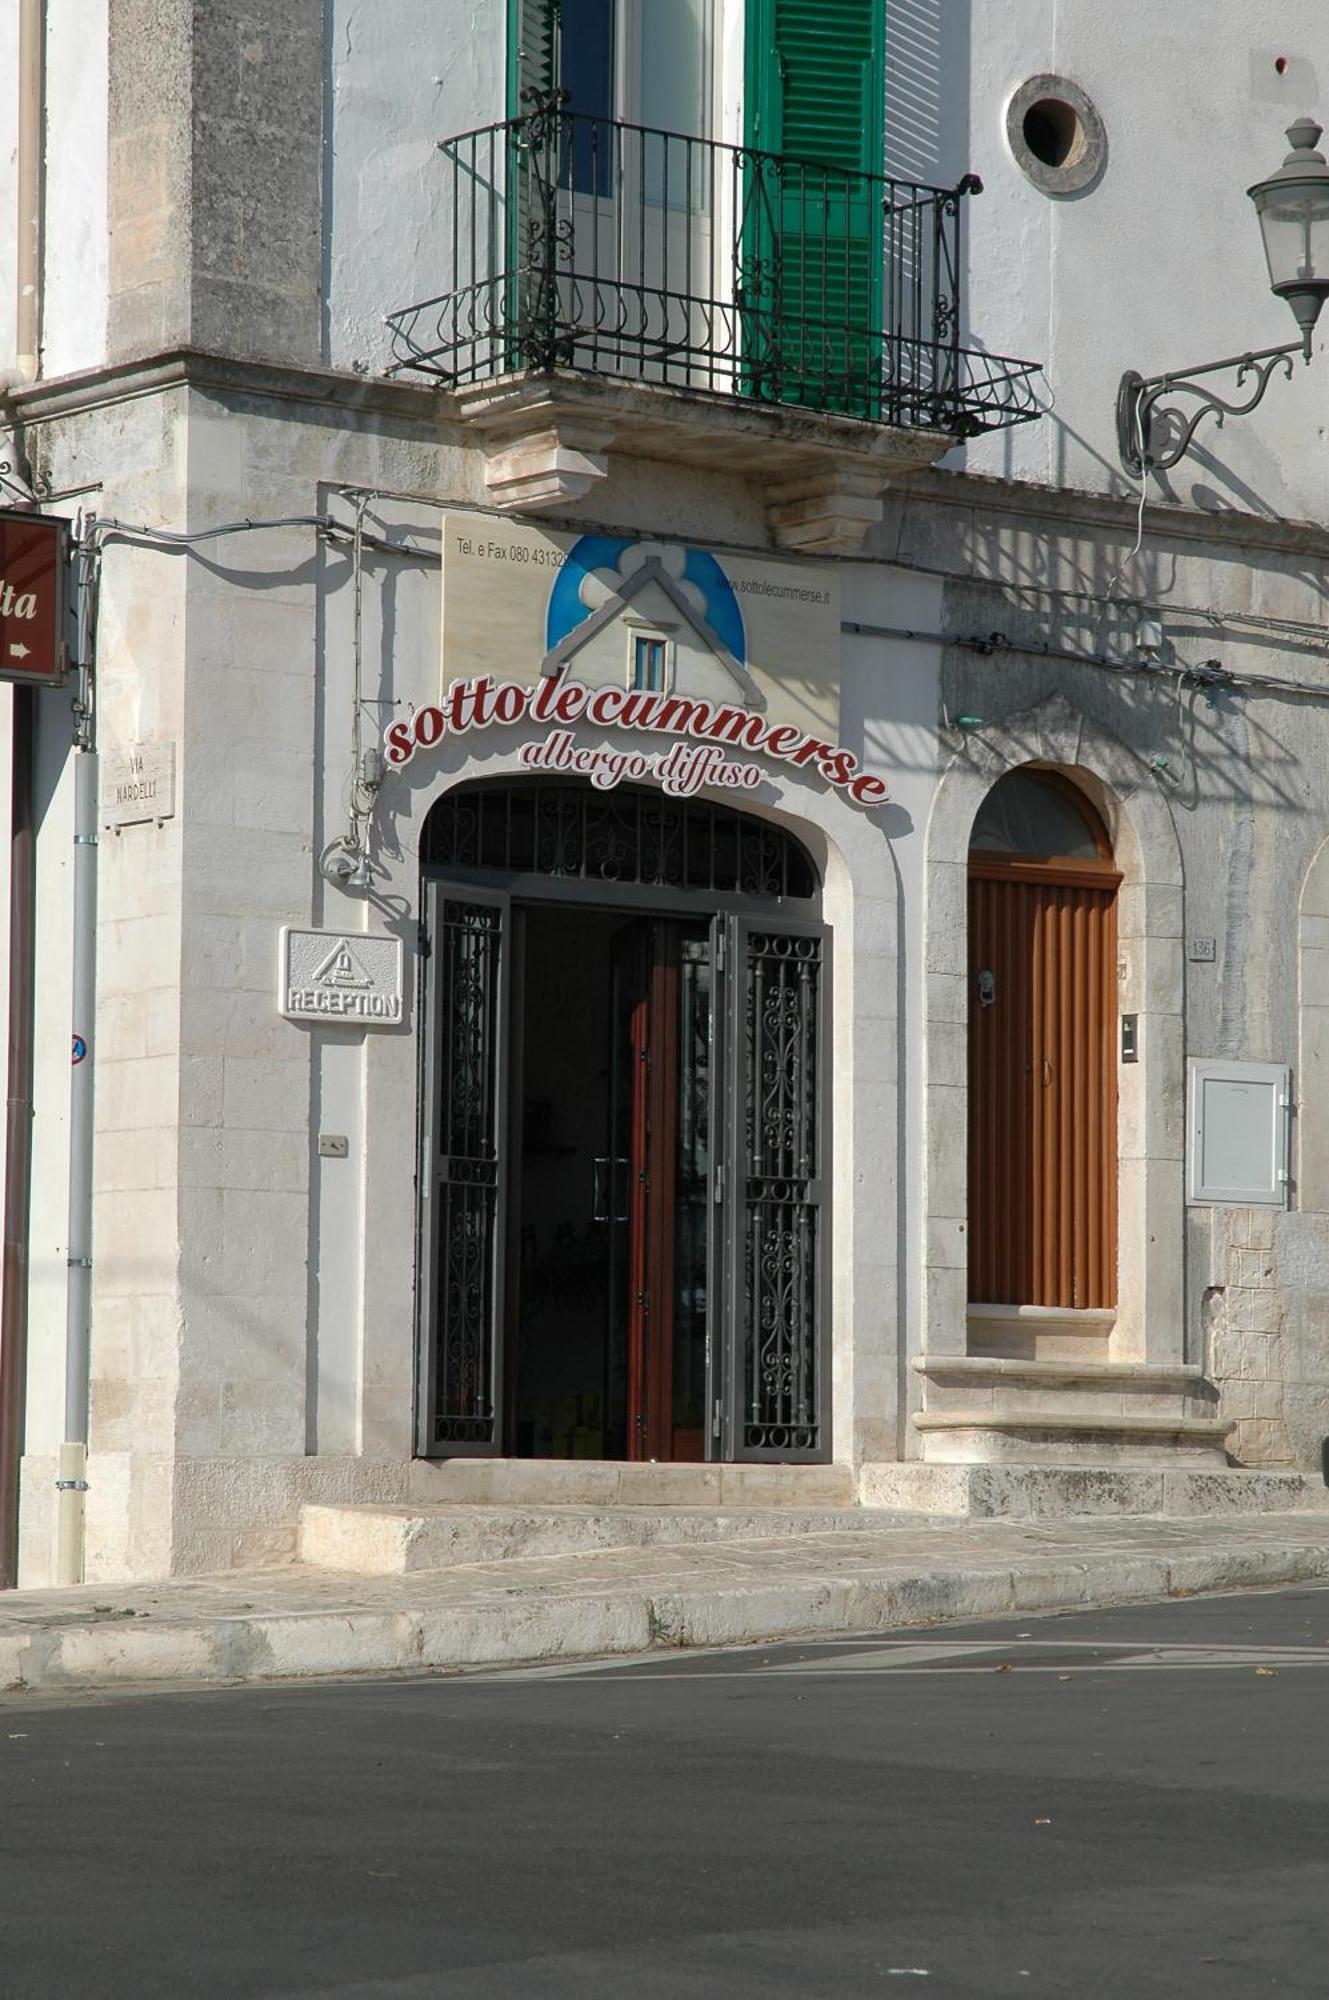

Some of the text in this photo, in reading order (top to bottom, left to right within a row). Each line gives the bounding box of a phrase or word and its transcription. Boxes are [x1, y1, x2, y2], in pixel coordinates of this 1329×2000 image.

[457, 537, 475, 555] Tel.
[478, 543, 485, 557] e
[488, 542, 507, 560] Fax
[510, 545, 529, 563] 080
[129, 757, 144, 774] VIA
[522, 731, 761, 794] albergo diffuso
[288, 988, 400, 1018] RECEPTION
